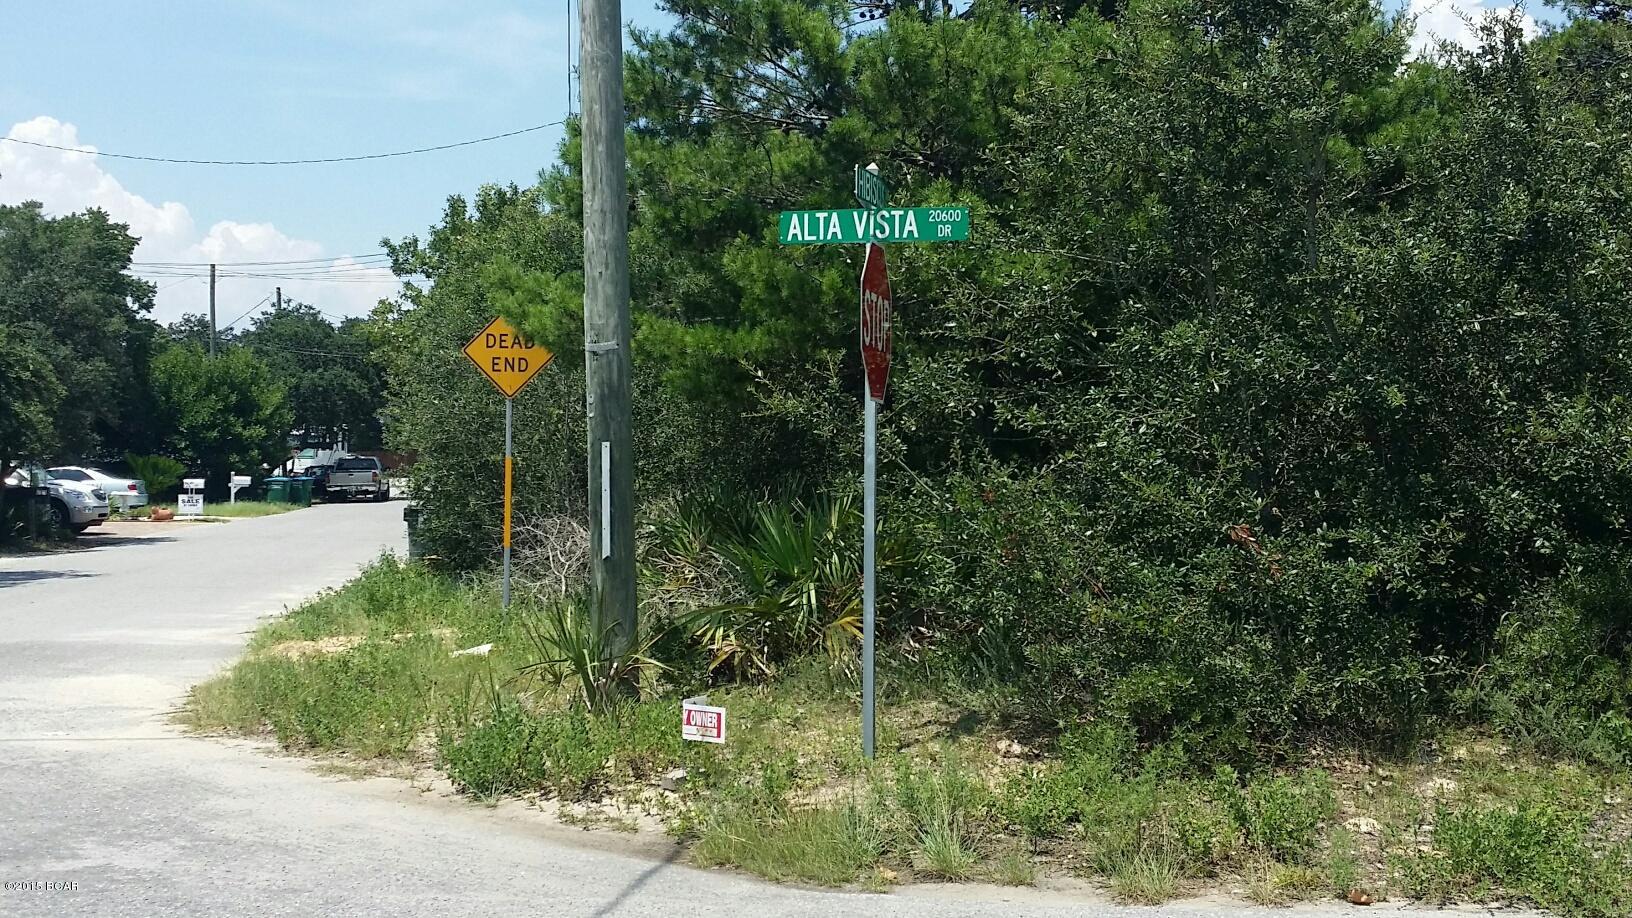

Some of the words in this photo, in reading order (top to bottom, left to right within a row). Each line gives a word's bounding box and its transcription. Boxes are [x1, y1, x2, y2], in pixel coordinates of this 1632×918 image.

[859, 168, 886, 209] HIBISC
[928, 210, 962, 222] 20600
[787, 212, 843, 241] ALTA
[852, 210, 919, 240] VISTA
[938, 224, 952, 237] DR
[864, 289, 890, 353] STOP
[486, 333, 535, 349] DEAD
[491, 357, 529, 372] END
[690, 711, 718, 728] OWNER
